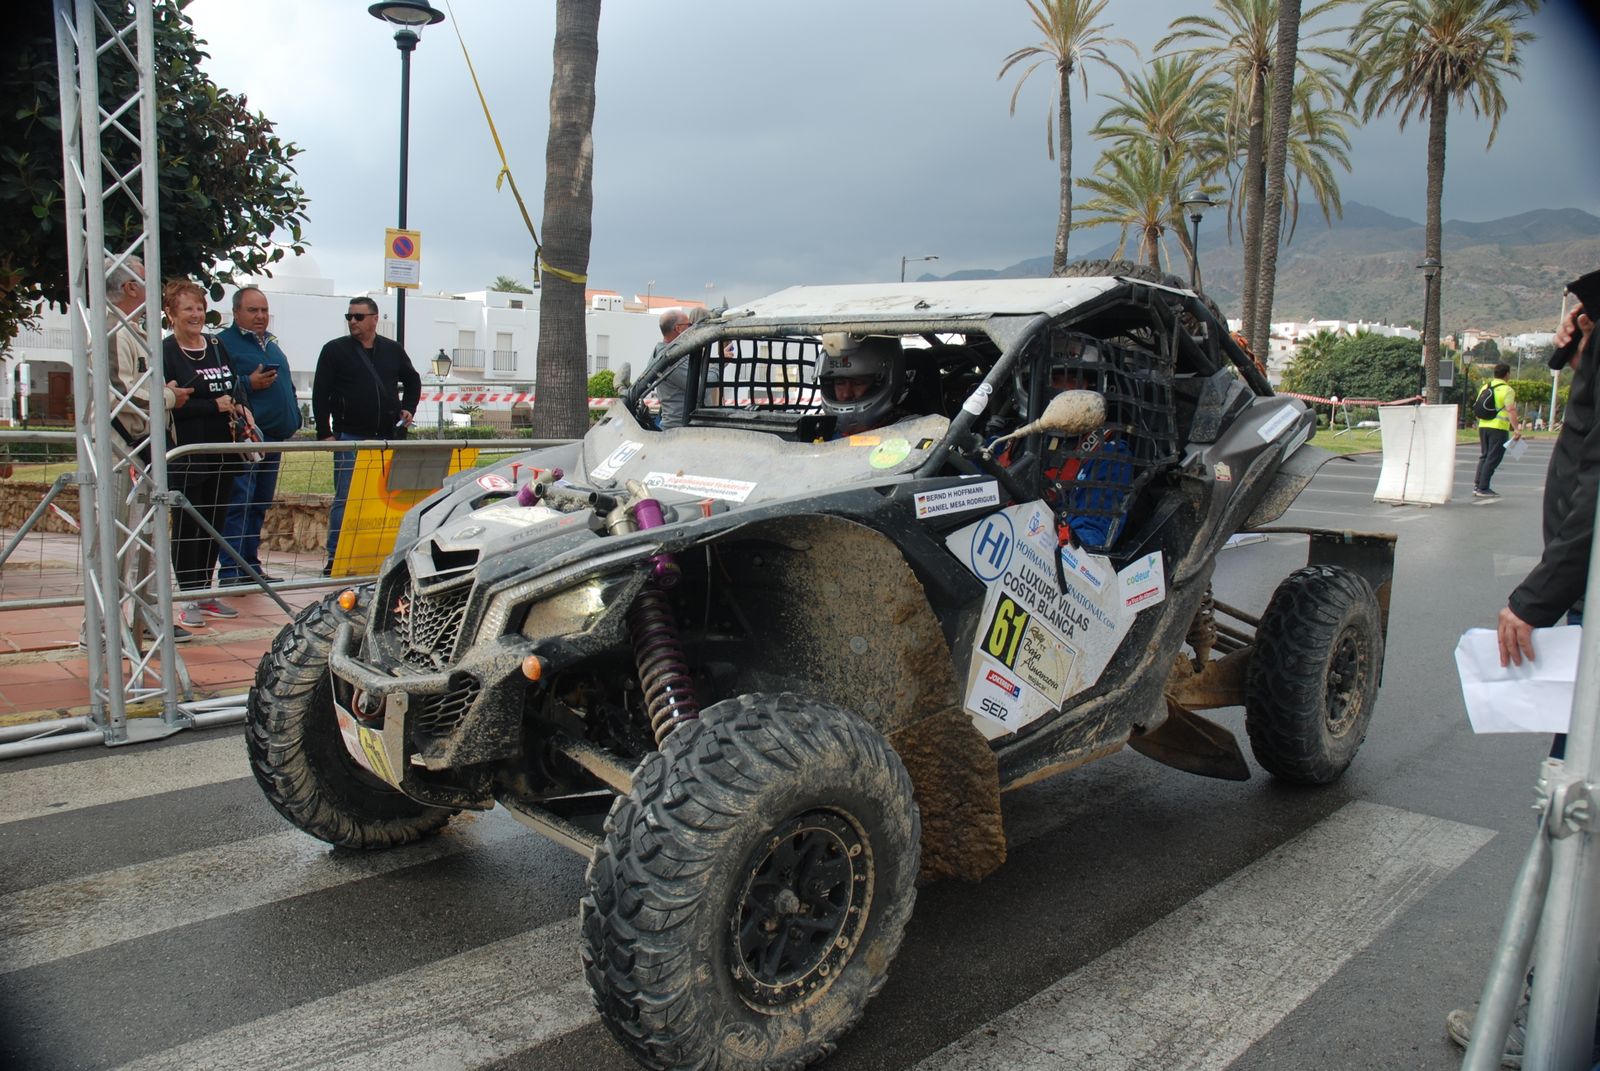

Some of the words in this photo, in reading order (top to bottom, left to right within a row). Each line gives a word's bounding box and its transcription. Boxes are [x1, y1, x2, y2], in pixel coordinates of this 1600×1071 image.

[209, 380, 233, 393] CLB
[926, 492, 947, 502] BERND
[947, 491, 953, 499] H
[953, 486, 984, 497] HOFFMANN
[927, 503, 949, 513] DANIEL
[949, 499, 966, 509] MESA
[966, 494, 997, 506] RODRIGUES
[976, 521, 1010, 570] HI
[1003, 571, 1036, 608] COSTA
[1037, 599, 1075, 640] BLANCA
[1019, 563, 1059, 604] LUXURY
[1058, 596, 1091, 632] VILLAS
[988, 598, 1028, 667] 61
[1023, 637, 1042, 662] Baja
[979, 697, 1009, 722] SER
